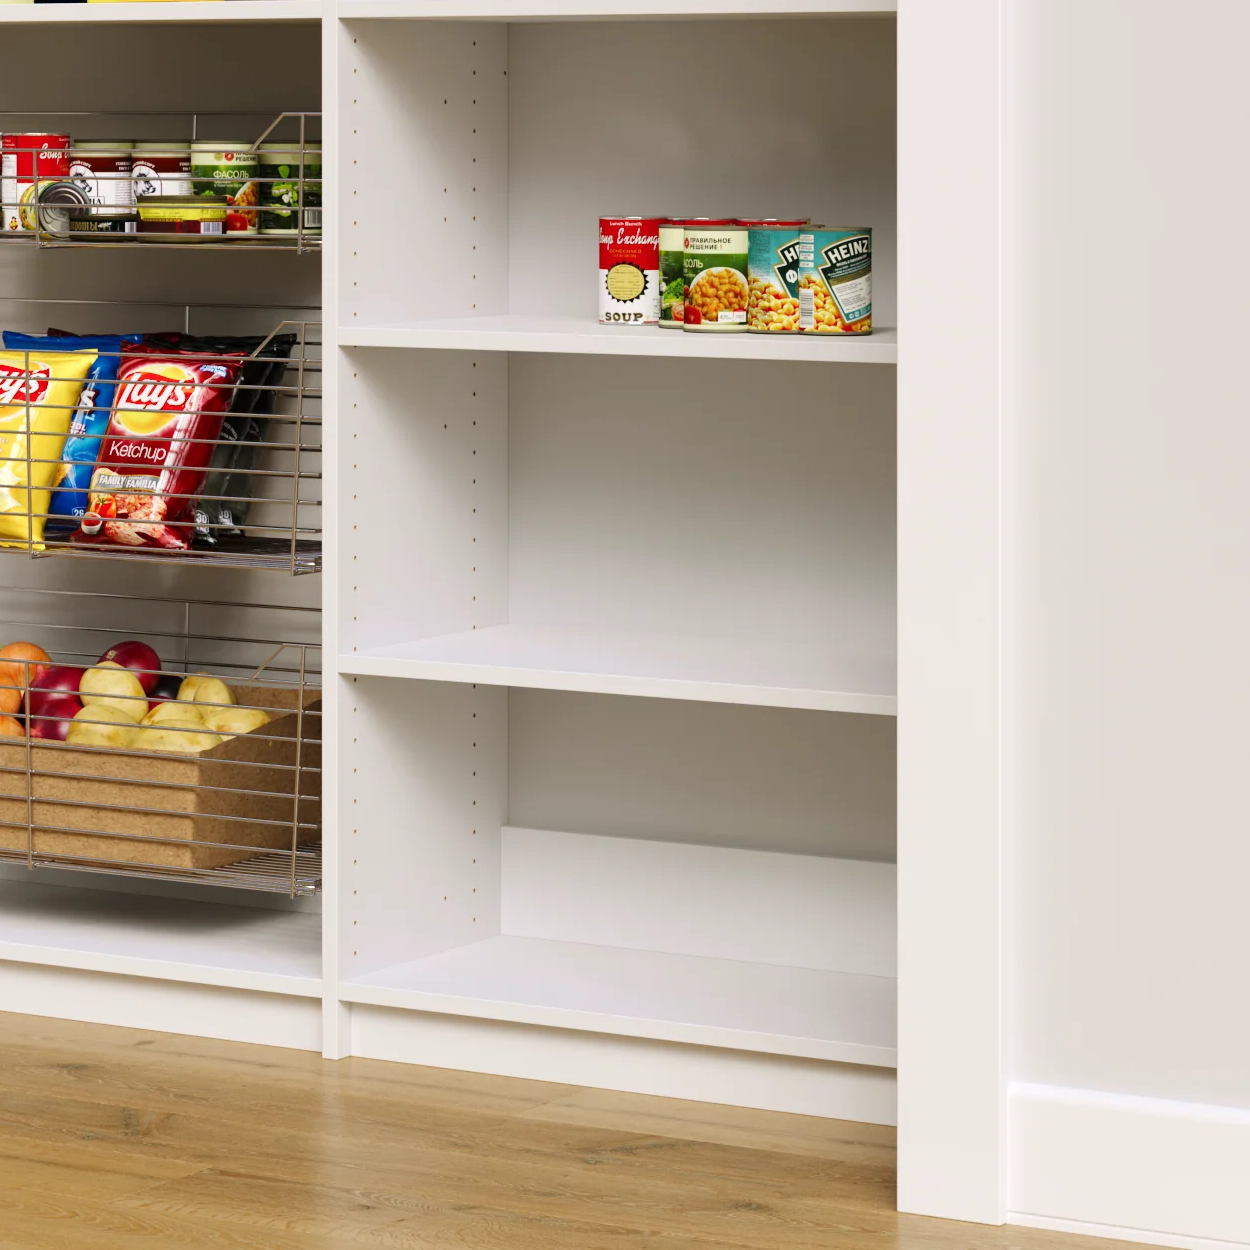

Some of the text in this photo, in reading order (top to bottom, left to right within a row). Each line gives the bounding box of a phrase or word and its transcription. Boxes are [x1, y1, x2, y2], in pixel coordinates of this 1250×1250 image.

[40, 143, 62, 165] Soup
[213, 170, 249, 178] ФАСОЛЬ
[617, 227, 659, 250] Exchang
[828, 240, 868, 264] HEINZ
[684, 259, 704, 268] СОЛЬ
[605, 312, 643, 321] SOUP
[117, 373, 192, 410] Lay's
[109, 441, 167, 463] Ketchup
[99, 474, 156, 490] FAMILY FAMILIA
[196, 513, 207, 523] 30
